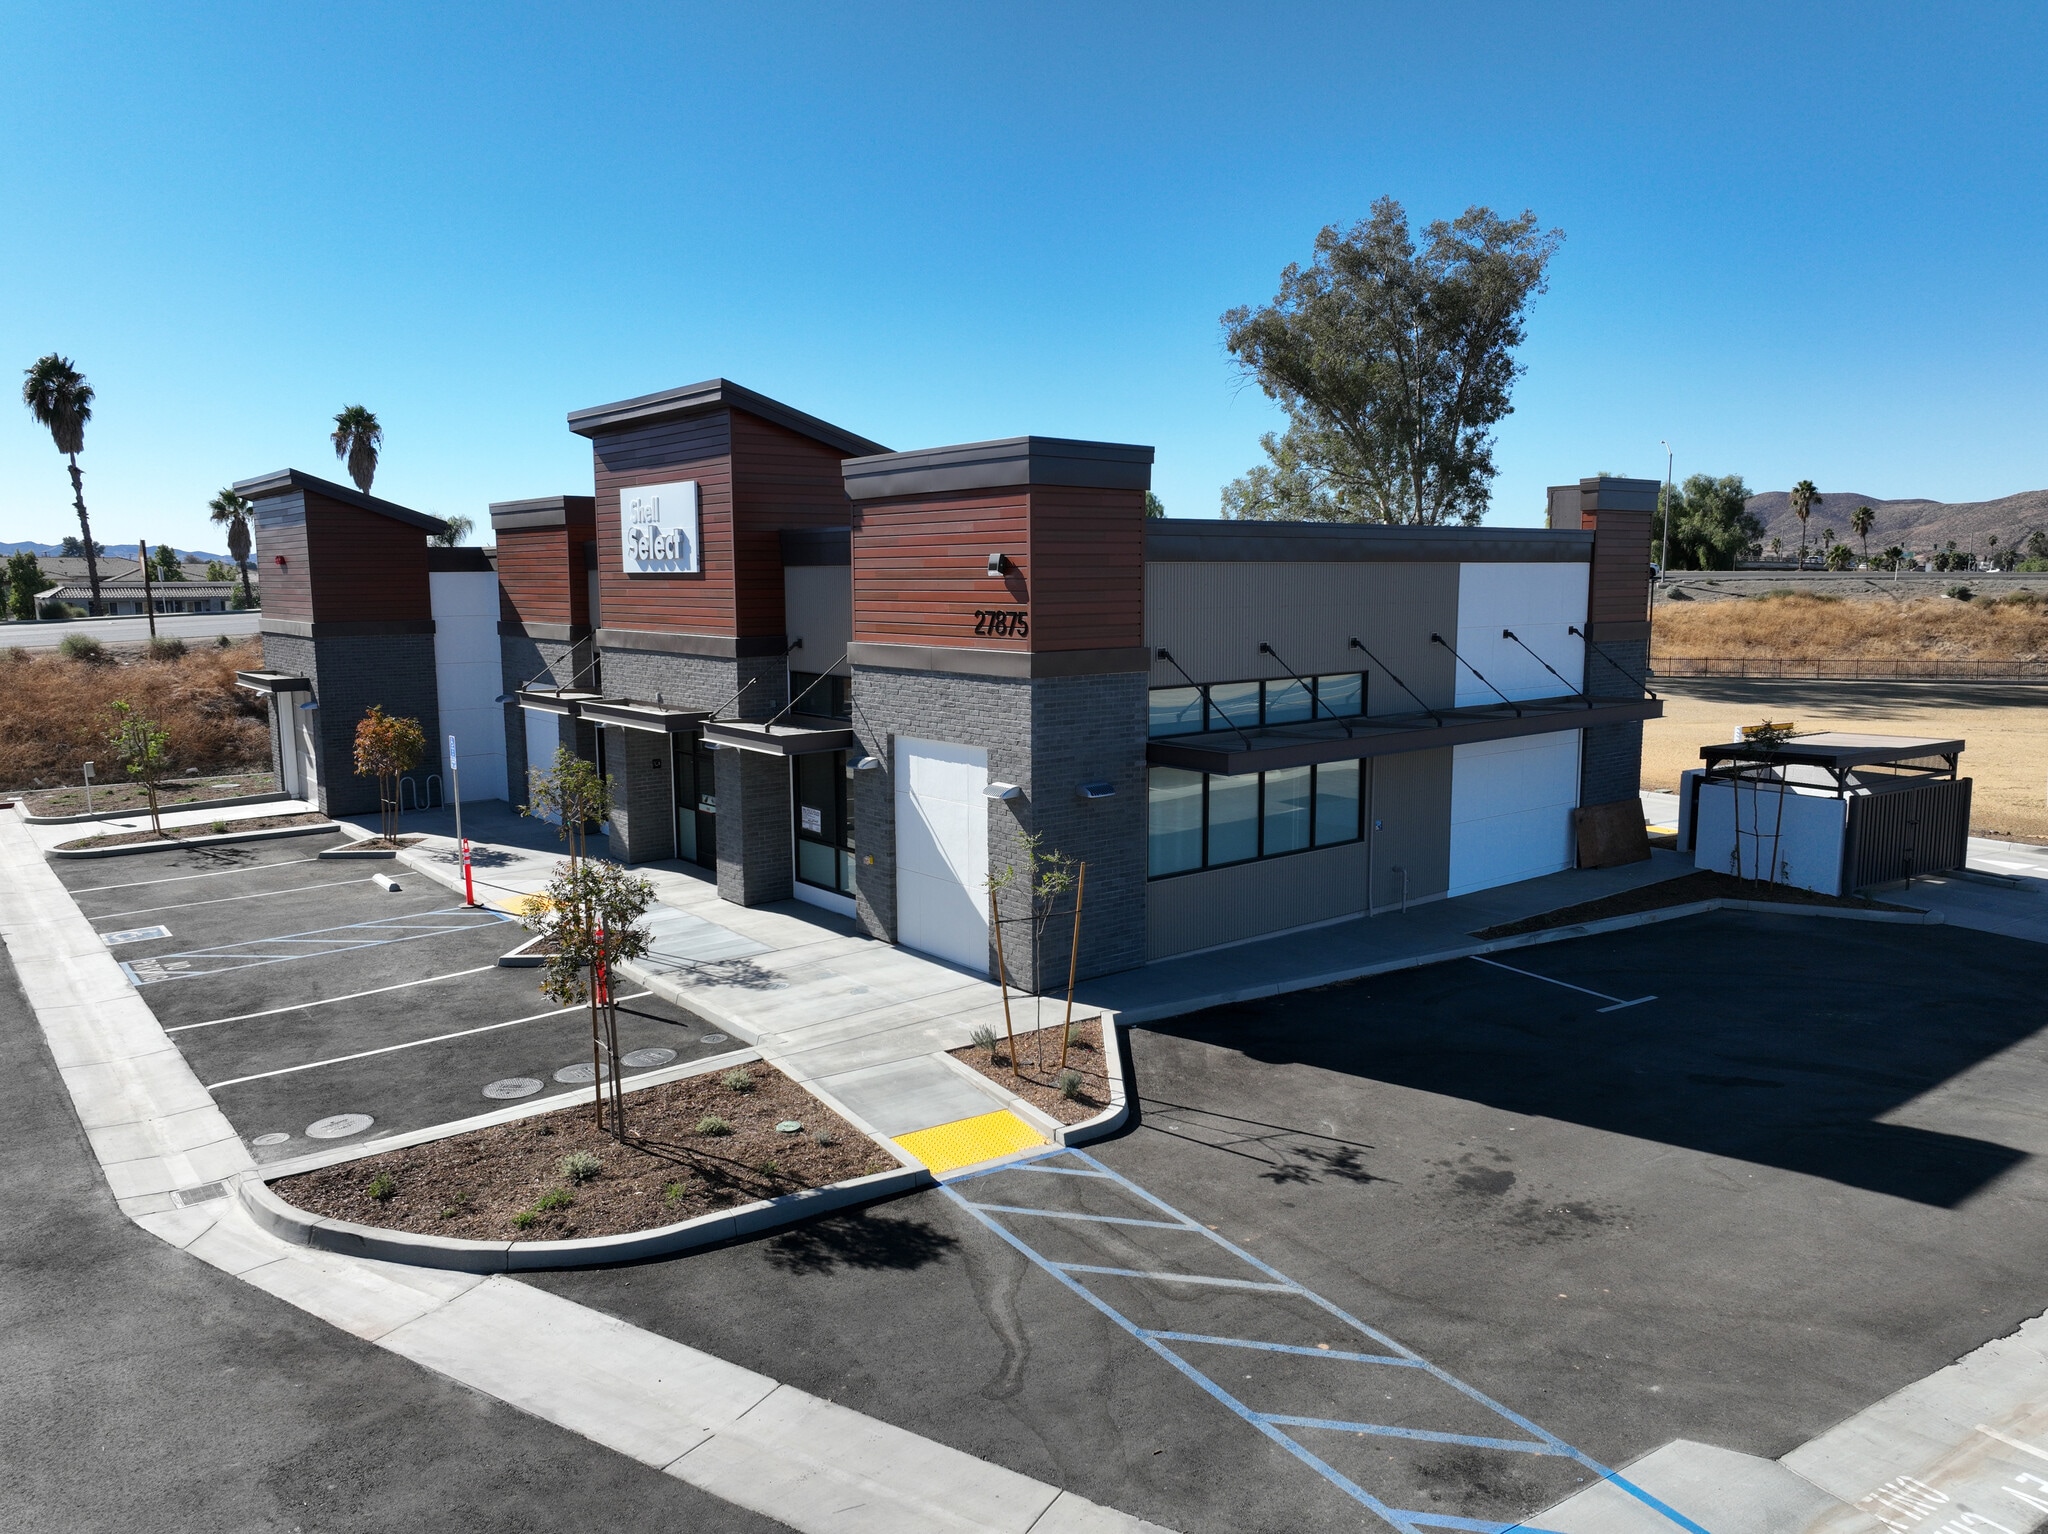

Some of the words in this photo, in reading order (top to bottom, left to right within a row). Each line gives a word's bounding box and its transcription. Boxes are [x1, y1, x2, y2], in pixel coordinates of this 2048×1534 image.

[630, 496, 660, 524] Shell
[627, 524, 682, 561] Select
[974, 610, 1028, 638] 27875
